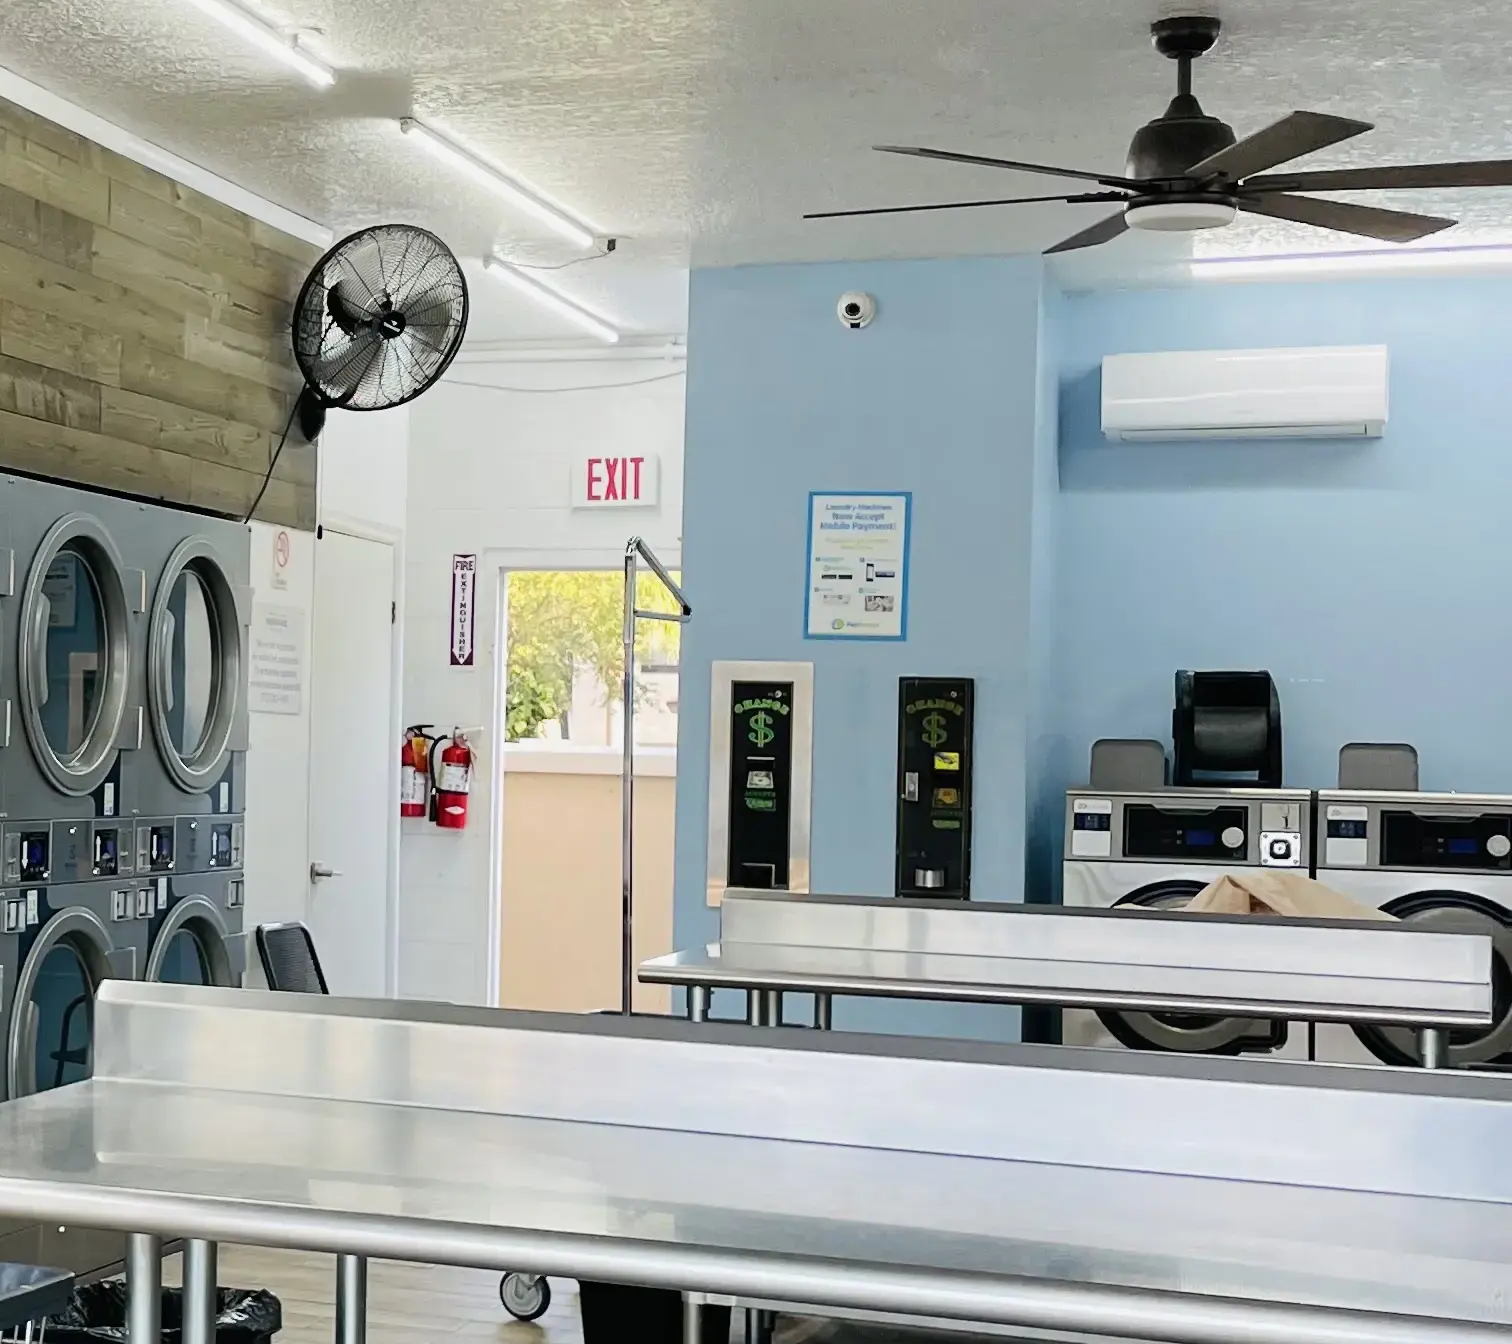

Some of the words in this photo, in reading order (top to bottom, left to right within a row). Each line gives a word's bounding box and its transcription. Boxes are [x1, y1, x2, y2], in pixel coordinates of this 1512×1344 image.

[587, 458, 644, 500] EXIT
[455, 561, 474, 570] FIRE
[458, 573, 467, 659] EXTINGUISHER
[734, 699, 789, 715] CHANGE
